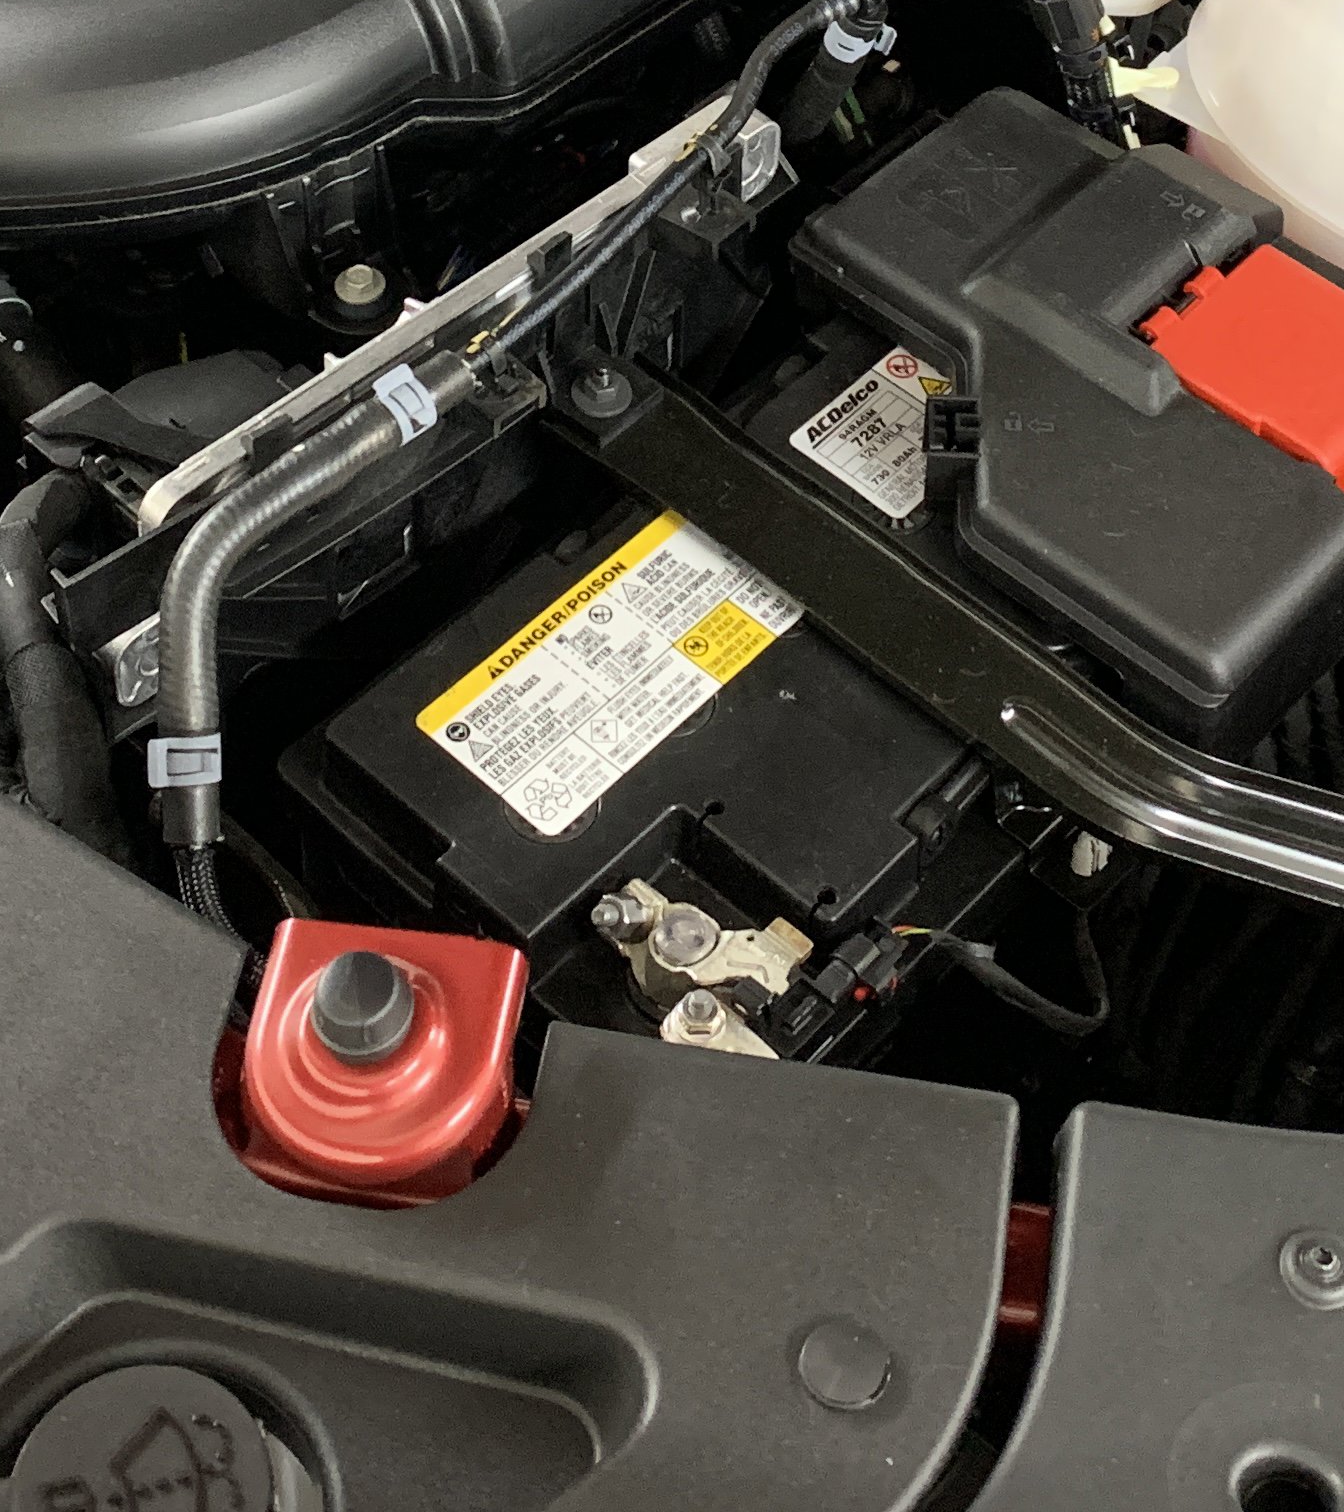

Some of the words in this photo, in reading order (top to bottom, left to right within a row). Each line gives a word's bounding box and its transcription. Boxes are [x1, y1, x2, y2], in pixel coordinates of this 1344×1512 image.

[806, 379, 879, 443] ACDelco
[850, 417, 887, 449] 7287
[859, 442, 880, 461] 12V
[878, 422, 907, 449] VRLA
[891, 445, 917, 468] 80Ah
[495, 559, 630, 669] DANGER/POISON
[472, 693, 517, 731] EXPLOSIVE
[512, 672, 542, 698] GASES
[516, 723, 536, 739] LES
[487, 763, 507, 780] LES
[502, 749, 523, 767] GAZ
